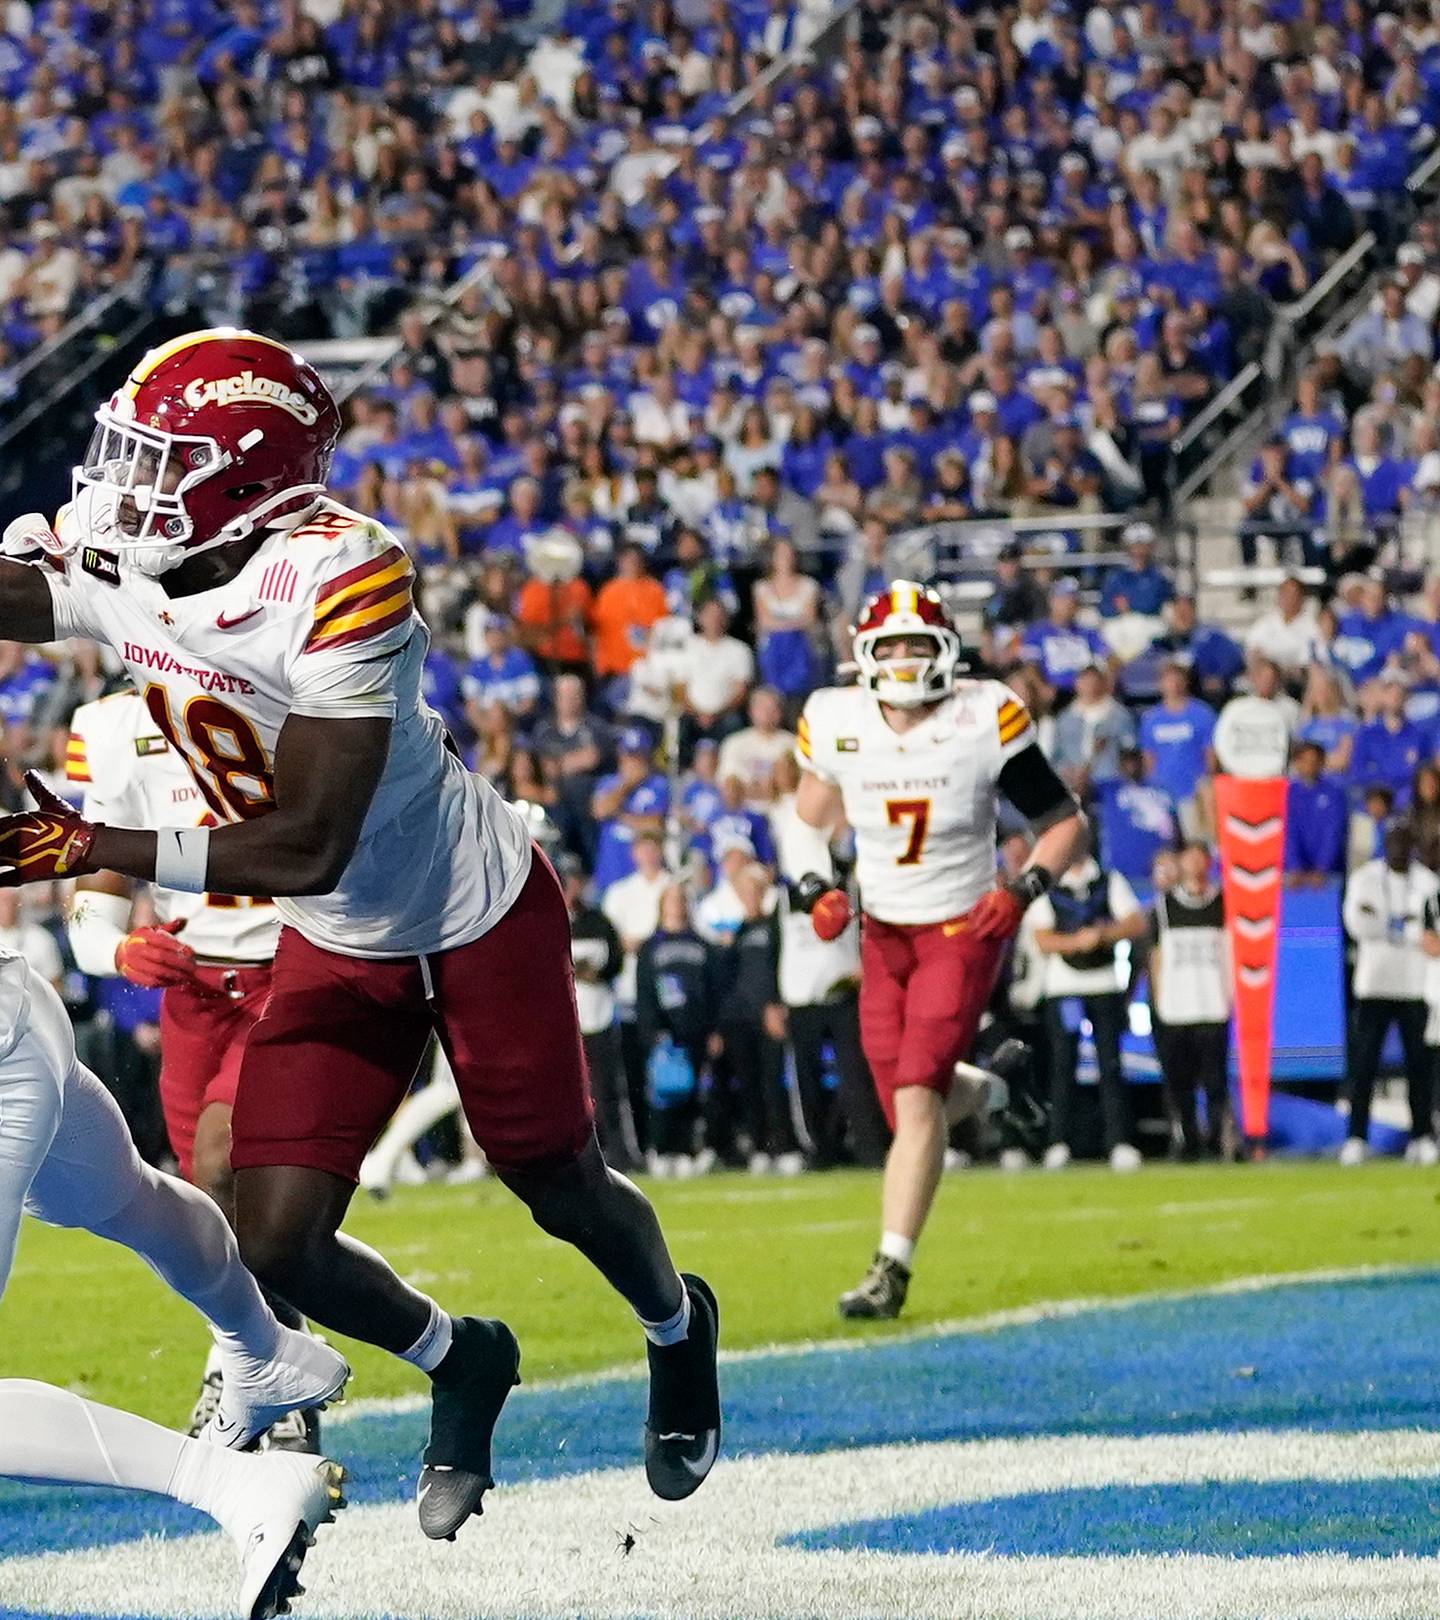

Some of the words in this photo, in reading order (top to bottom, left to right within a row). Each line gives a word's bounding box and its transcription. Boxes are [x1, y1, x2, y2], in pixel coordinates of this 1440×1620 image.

[184, 667, 256, 696] TATE
[143, 681, 277, 823] 18
[885, 798, 933, 867] 7
